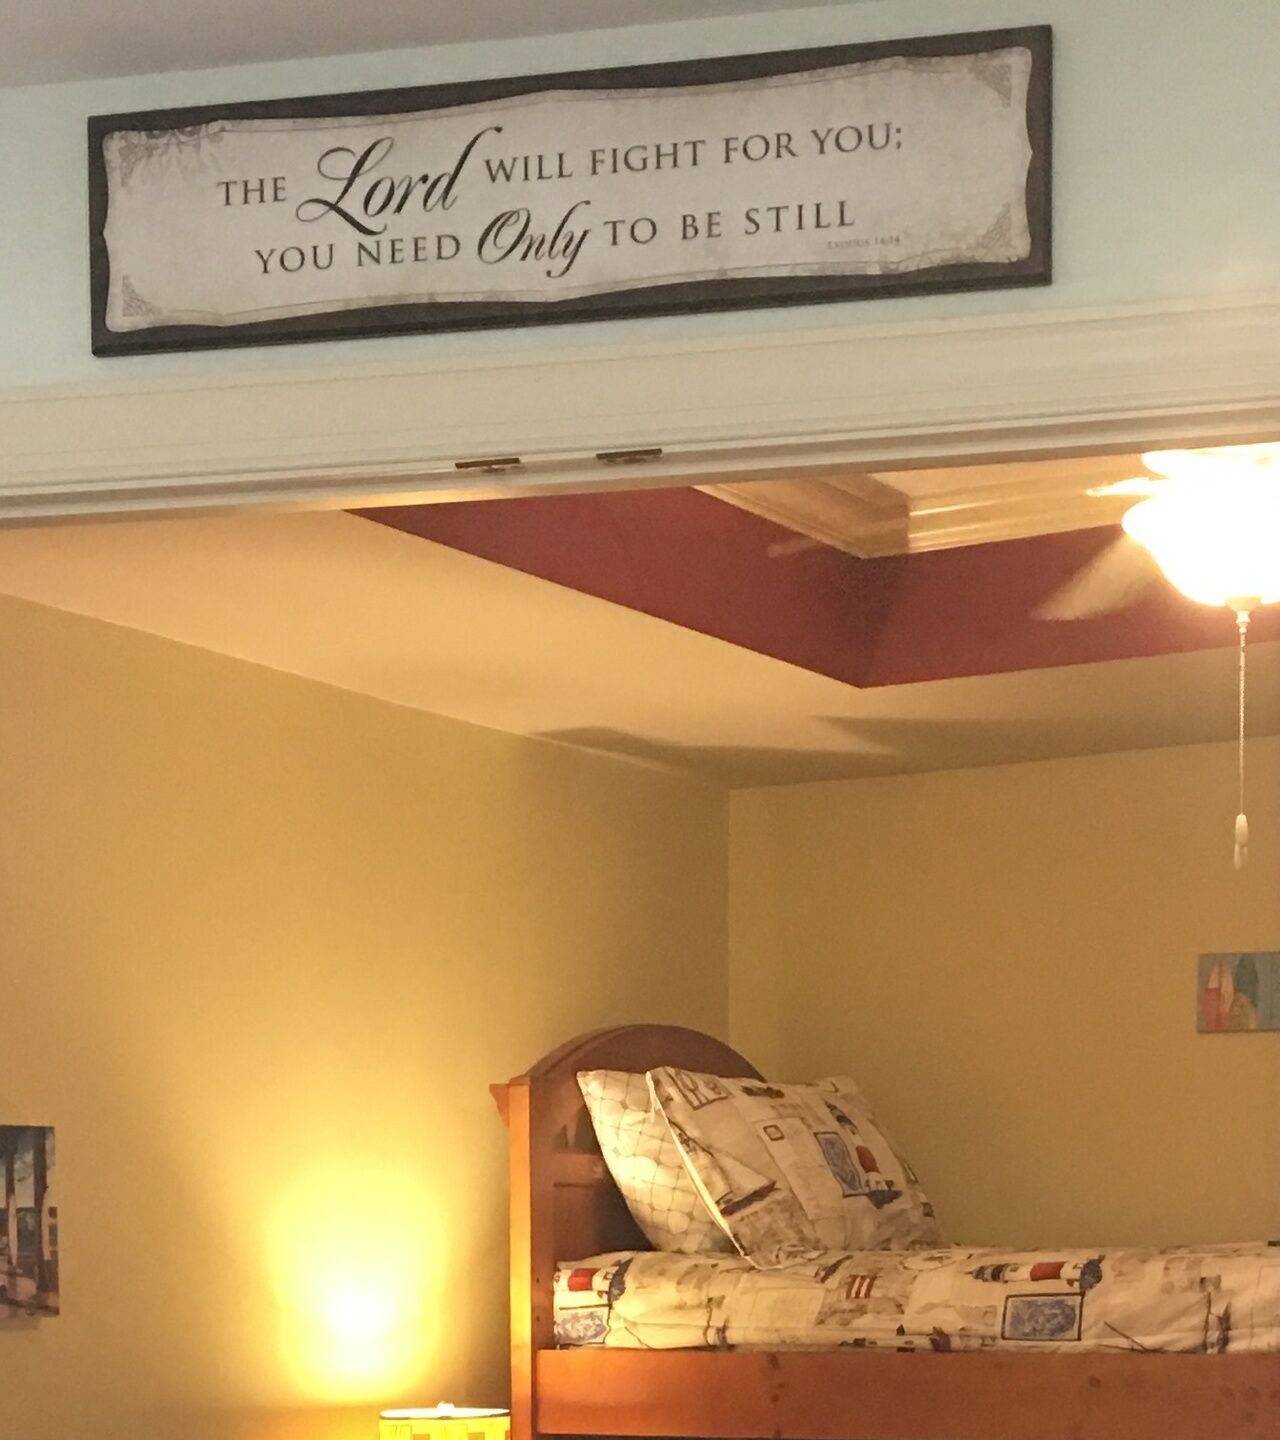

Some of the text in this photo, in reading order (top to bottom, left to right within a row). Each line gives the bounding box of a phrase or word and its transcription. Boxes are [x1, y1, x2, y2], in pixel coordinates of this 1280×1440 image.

[216, 122, 903, 235] THE Lord WILL FIGHT FOR YOU;
[255, 200, 855, 279] YOU NEED Only TO BE STILL
